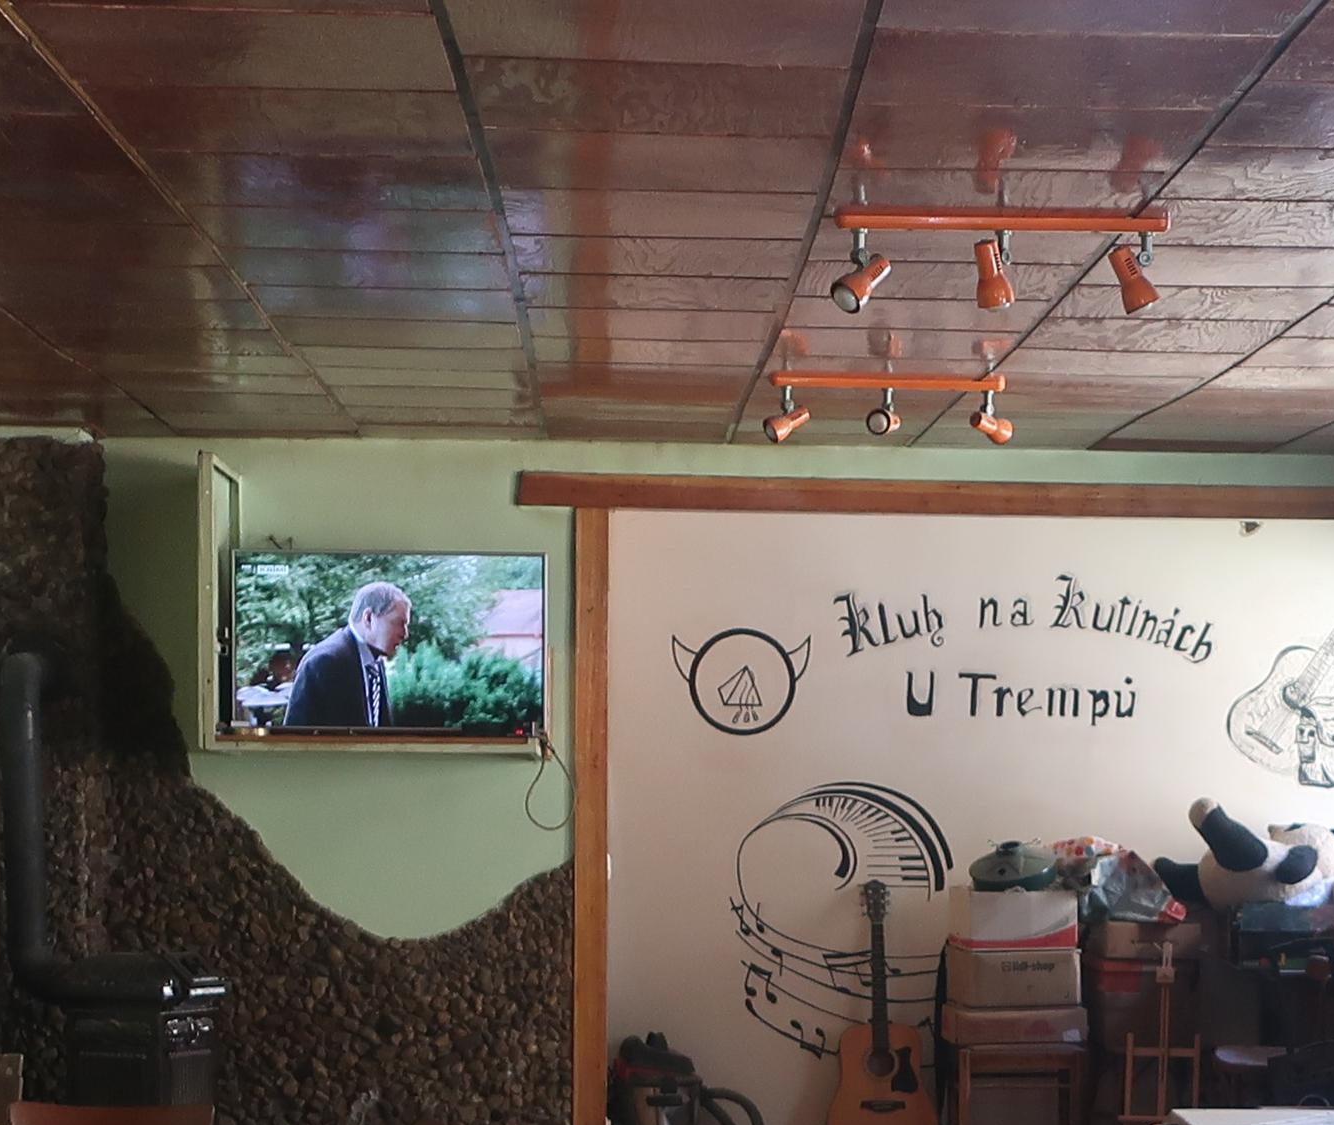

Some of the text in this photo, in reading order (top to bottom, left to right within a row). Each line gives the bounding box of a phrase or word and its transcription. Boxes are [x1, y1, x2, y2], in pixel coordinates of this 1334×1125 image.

[833, 593, 944, 657] Klub
[978, 597, 1035, 628] na
[906, 671, 1137, 726] U Trempů
